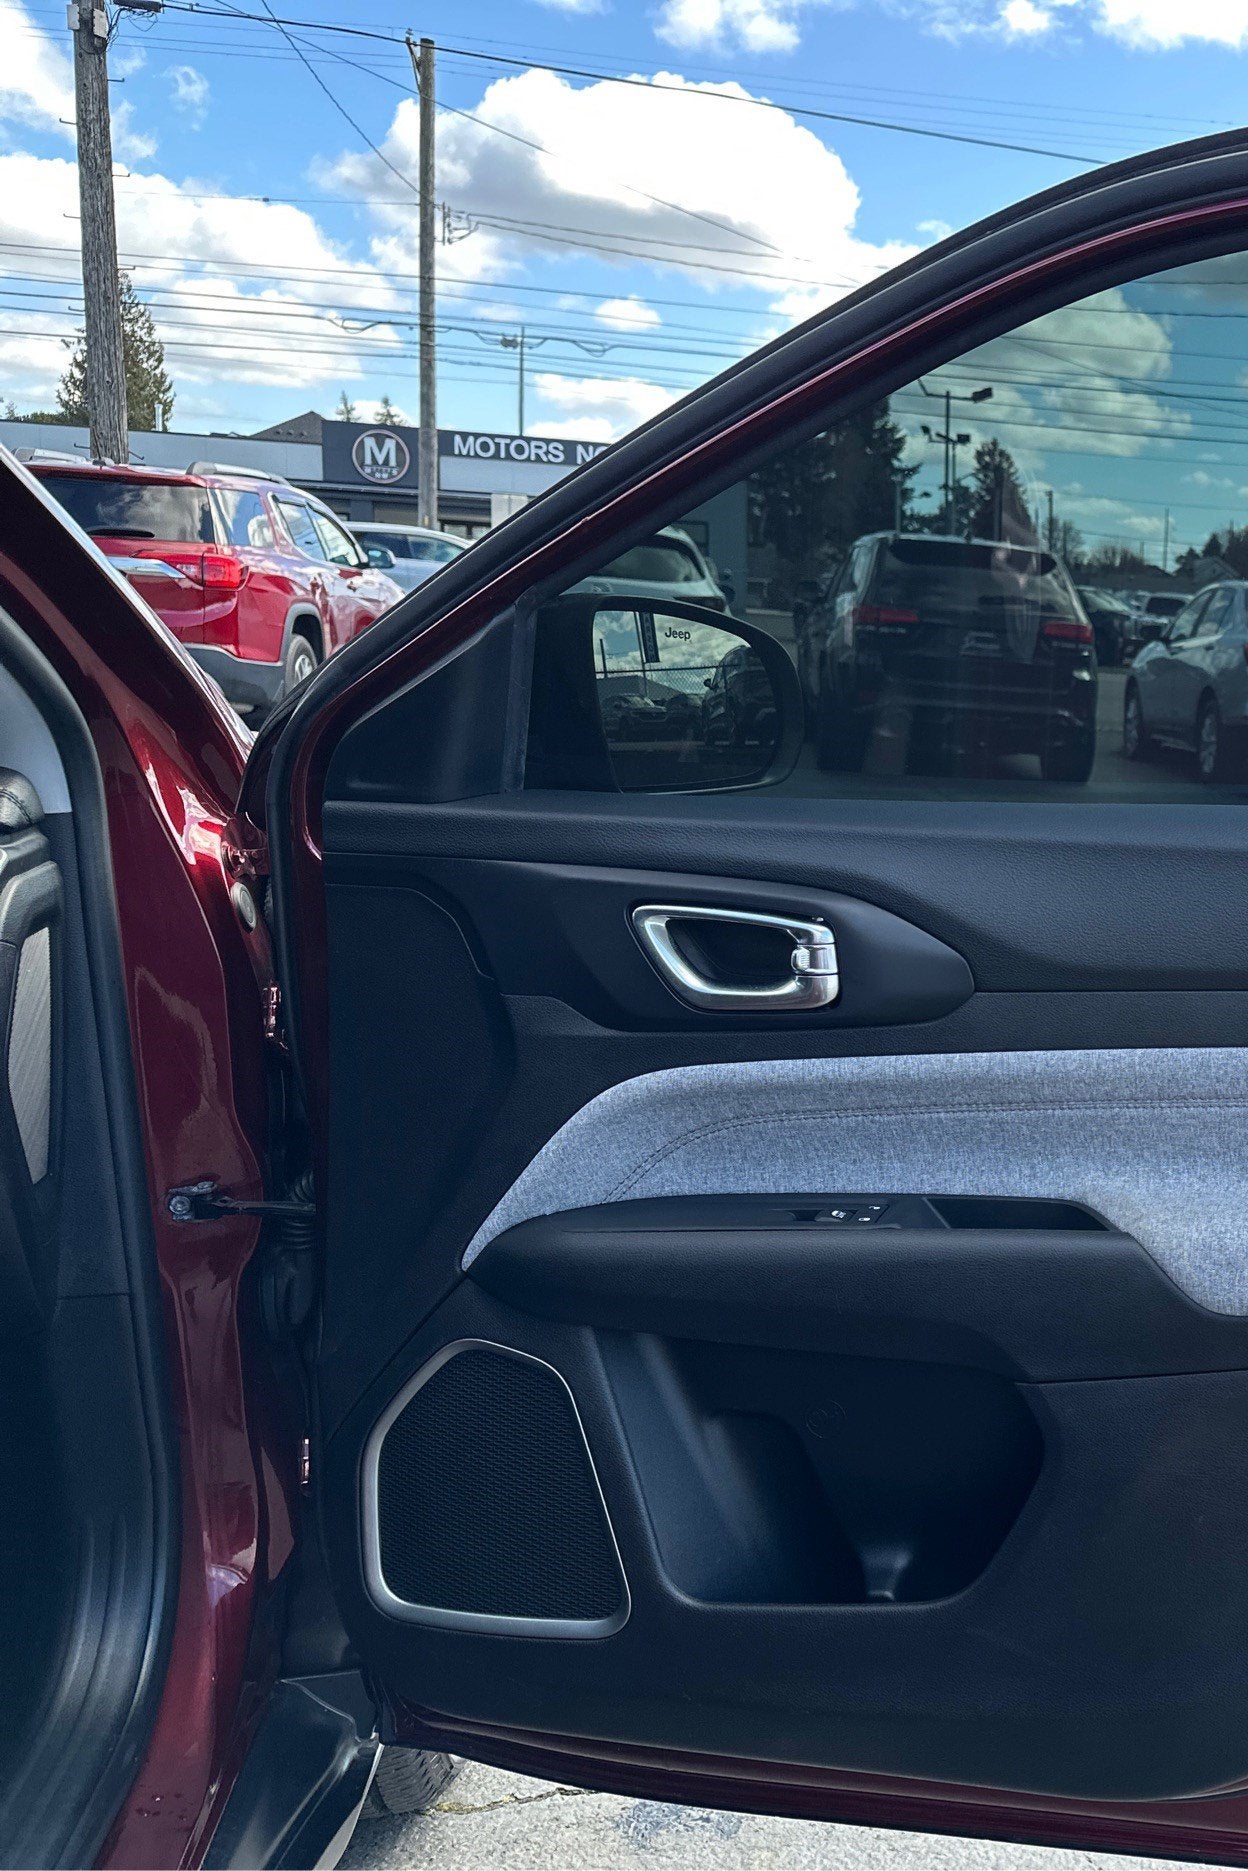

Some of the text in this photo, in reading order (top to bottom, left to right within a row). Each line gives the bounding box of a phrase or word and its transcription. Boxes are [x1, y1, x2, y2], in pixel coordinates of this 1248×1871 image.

[363, 436, 397, 467] M
[453, 433, 566, 464] MOTORS
[664, 626, 691, 642] Jeep
